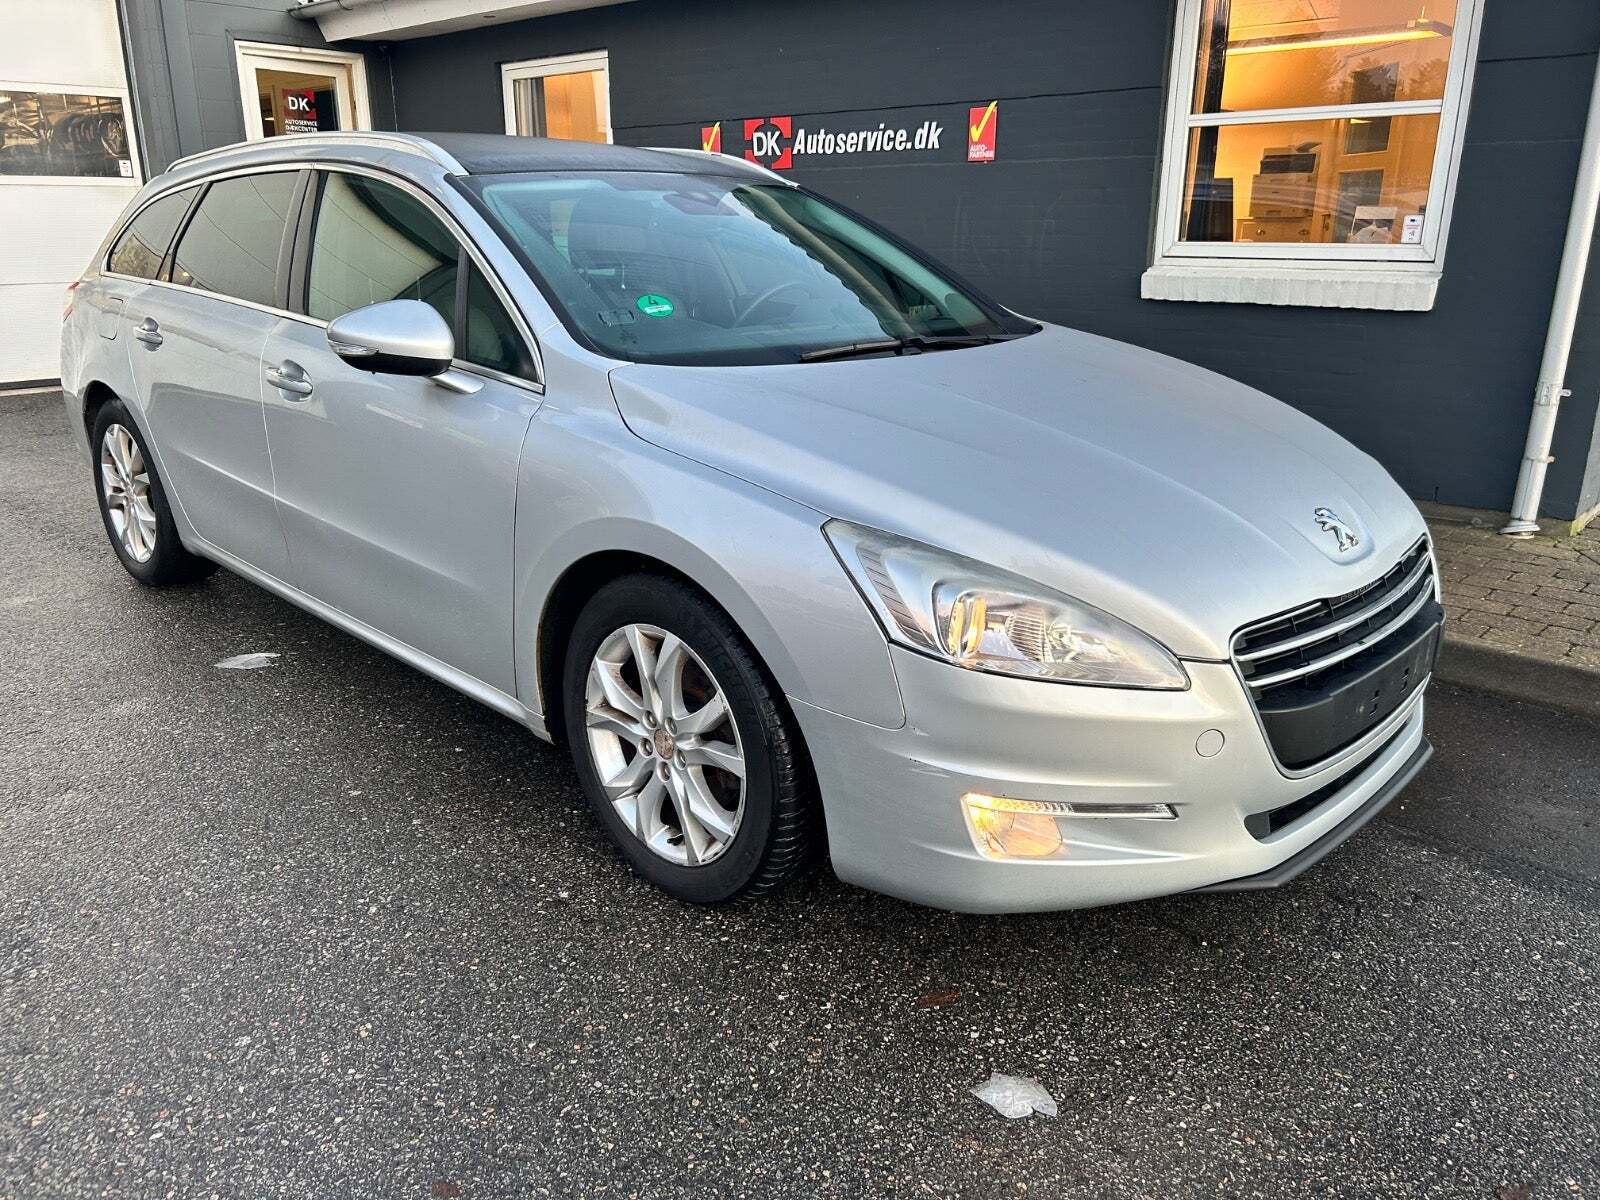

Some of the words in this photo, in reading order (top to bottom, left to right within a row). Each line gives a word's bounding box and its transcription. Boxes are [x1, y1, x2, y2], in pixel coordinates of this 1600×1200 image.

[287, 96, 310, 111] DK
[752, 131, 782, 157] DK
[792, 121, 944, 155] Autoservice.dk
